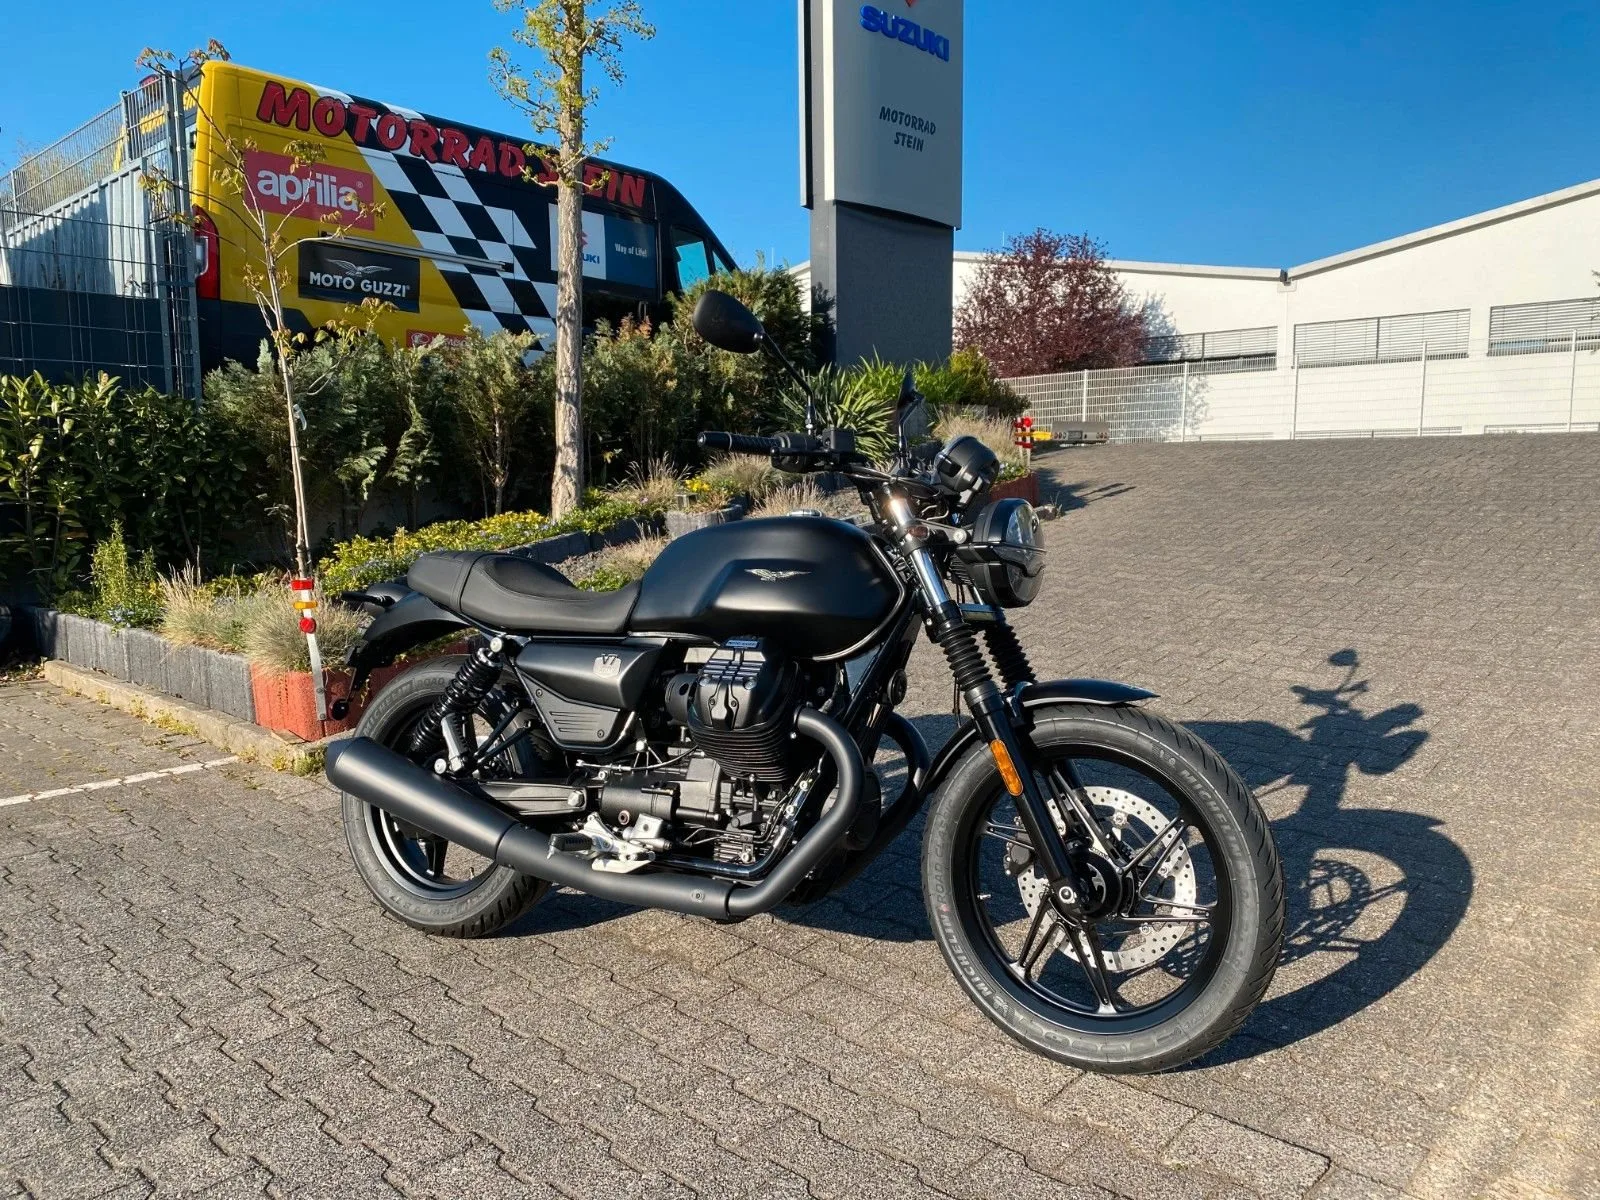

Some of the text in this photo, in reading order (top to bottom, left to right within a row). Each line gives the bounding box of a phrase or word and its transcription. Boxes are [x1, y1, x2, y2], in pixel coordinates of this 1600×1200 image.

[860, 5, 950, 62] SUZUKI
[879, 105, 937, 135] MOTORRAD
[256, 80, 645, 208] MOTORRAD SEIN
[893, 132, 924, 152] STEIN
[256, 169, 359, 212] aprilia
[614, 242, 627, 255] Way
[628, 246, 634, 255] of
[309, 271, 406, 297] MOTO GUZZI
[601, 653, 619, 666] V7
[934, 863, 947, 904] ROAD
[940, 911, 995, 998] MICHELIN
